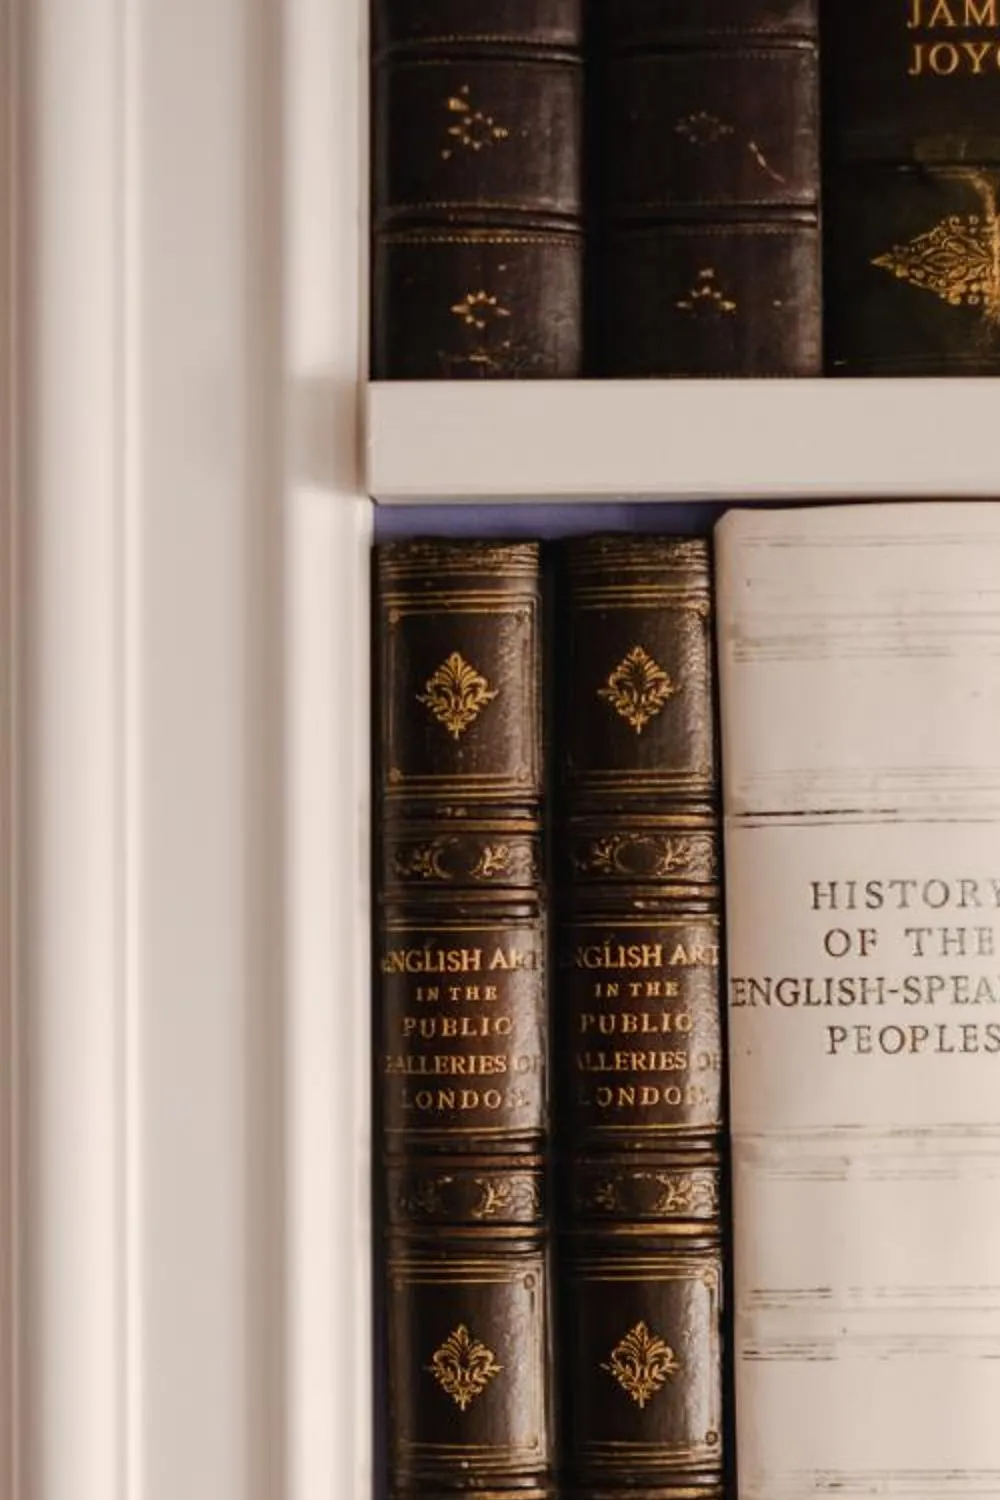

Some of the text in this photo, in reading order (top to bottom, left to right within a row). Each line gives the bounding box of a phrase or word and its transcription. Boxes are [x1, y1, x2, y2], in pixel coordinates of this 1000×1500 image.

[824, 927, 996, 958] OF THE
[575, 943, 662, 970] NGLISH
[416, 986, 498, 1002] IN THE
[595, 982, 682, 998] IN THE
